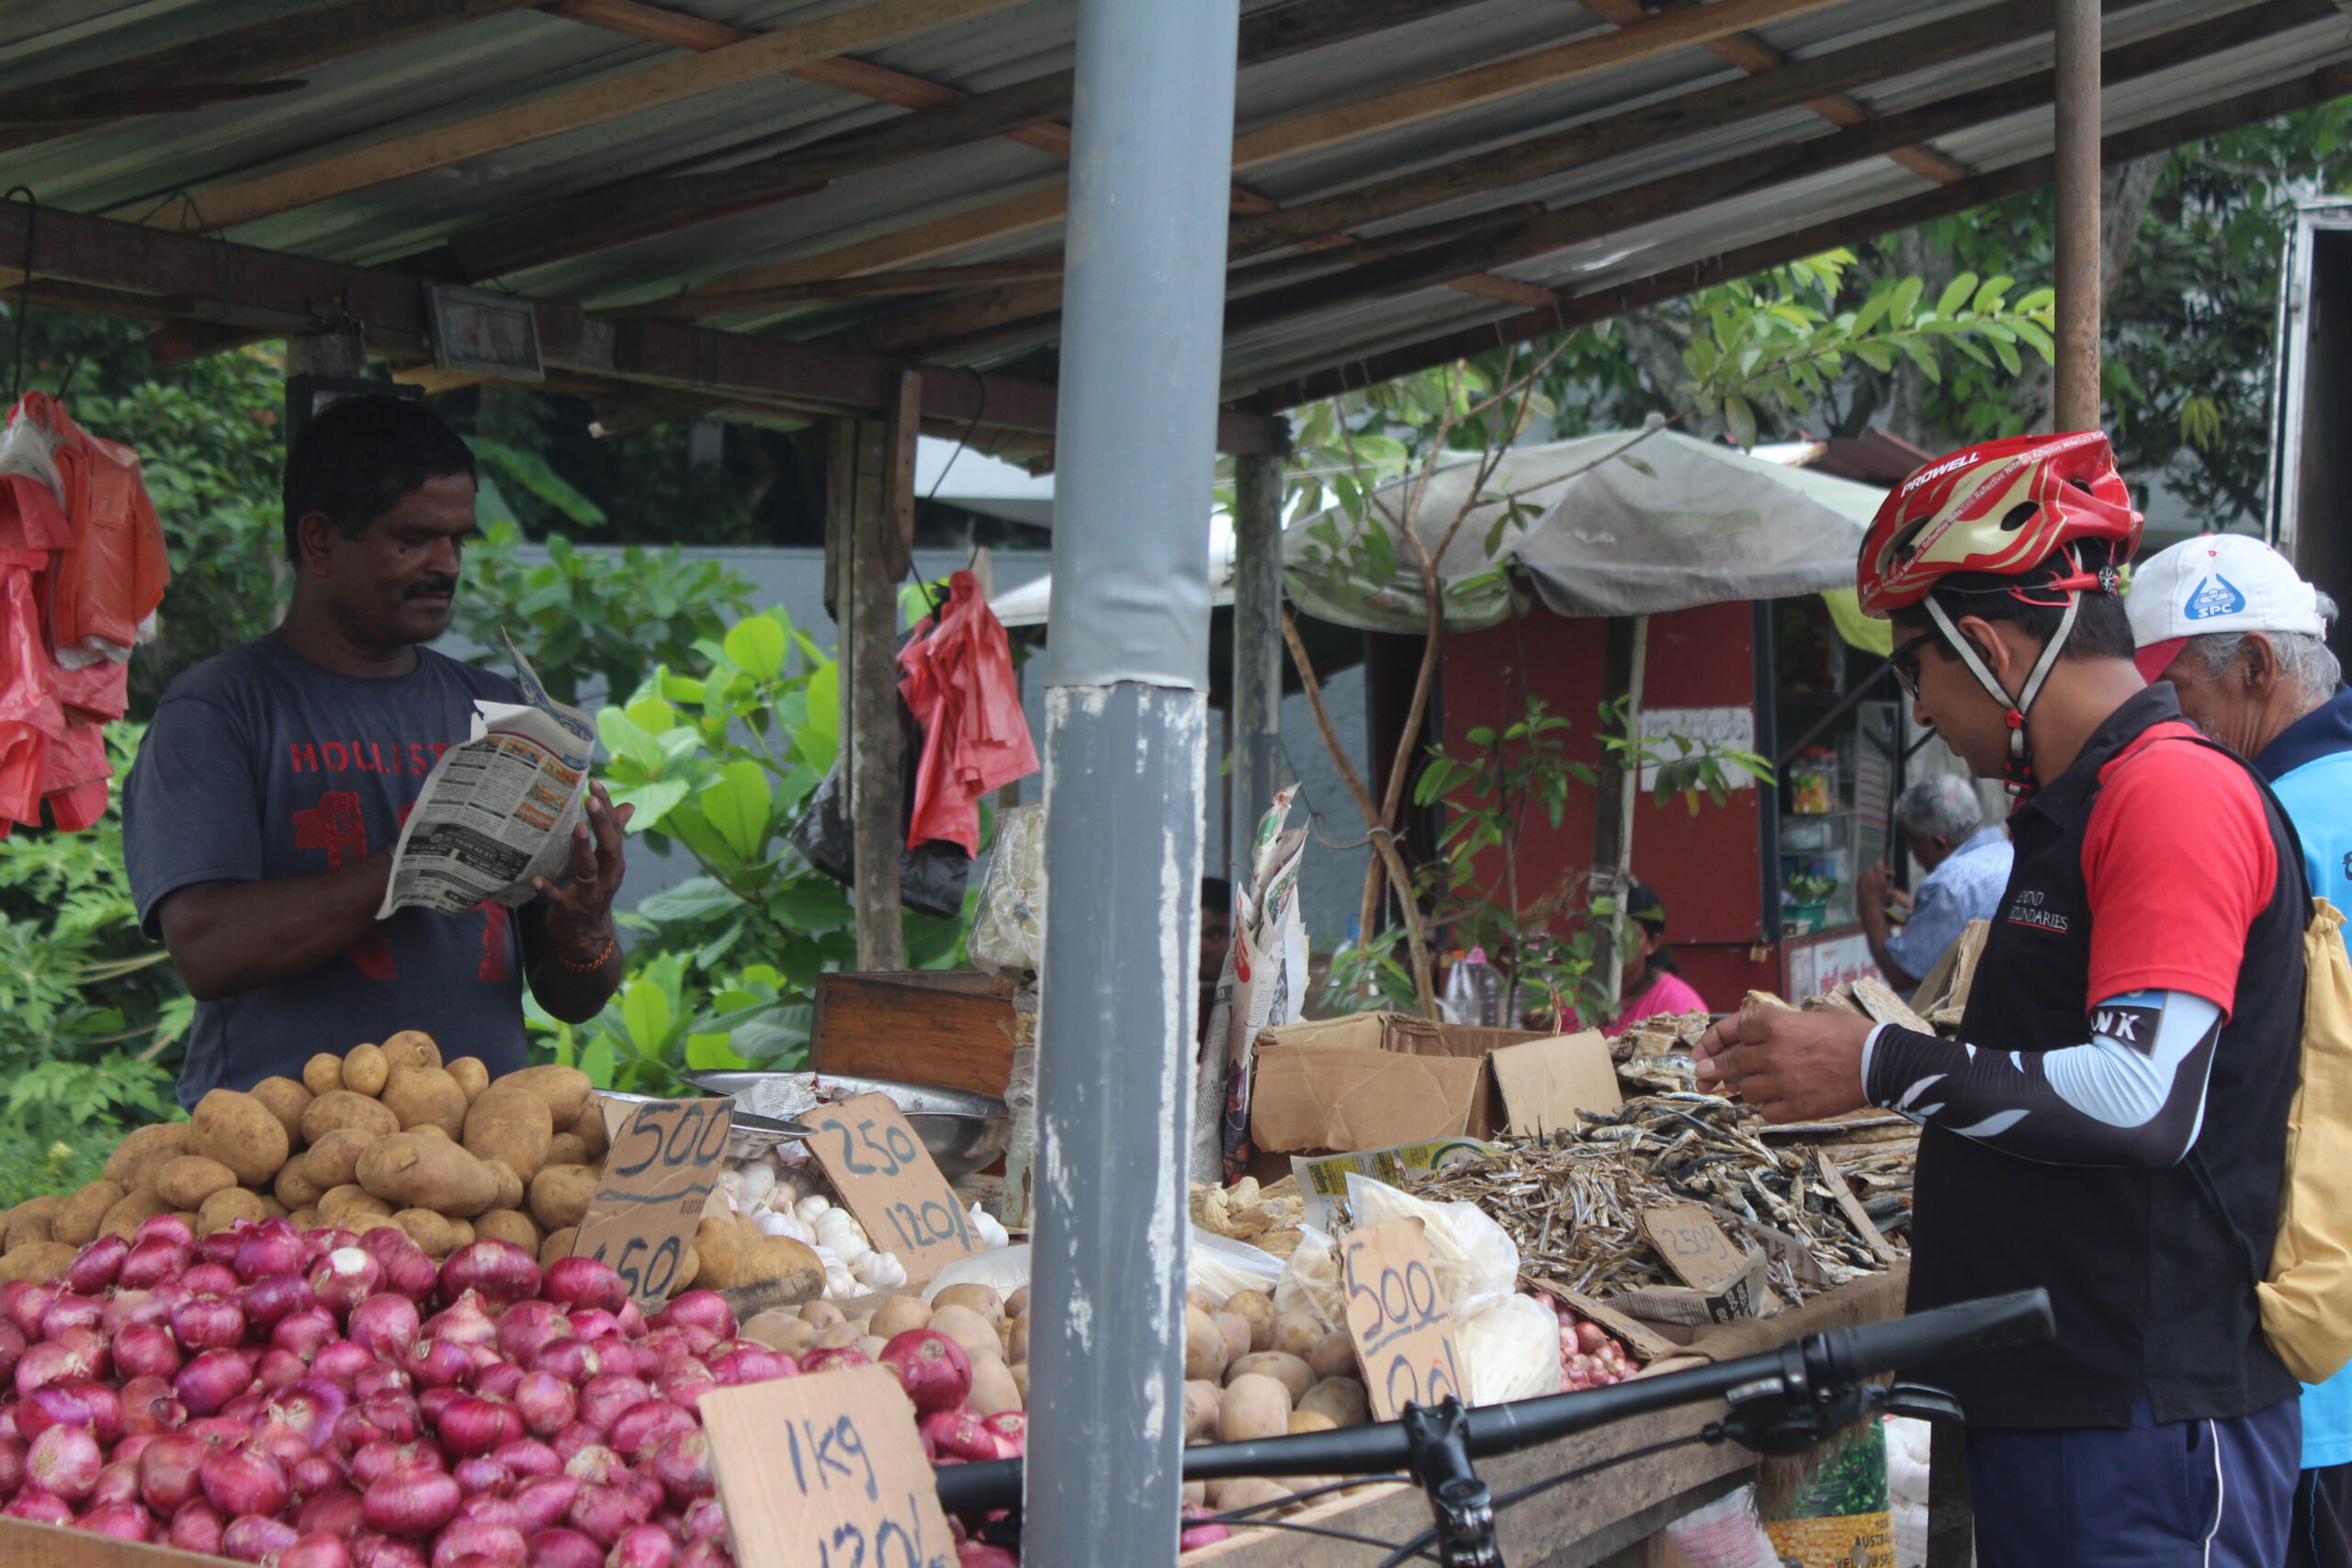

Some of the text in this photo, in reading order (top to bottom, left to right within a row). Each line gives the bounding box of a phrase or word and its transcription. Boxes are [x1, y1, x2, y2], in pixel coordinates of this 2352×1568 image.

[1900, 452, 1980, 498] PROWELL
[2197, 603, 2233, 618] SPC
[613, 1100, 734, 1178] 500
[820, 1118, 917, 1177] 250
[593, 1235, 681, 1297] 50
[1345, 1241, 1435, 1341] 500
